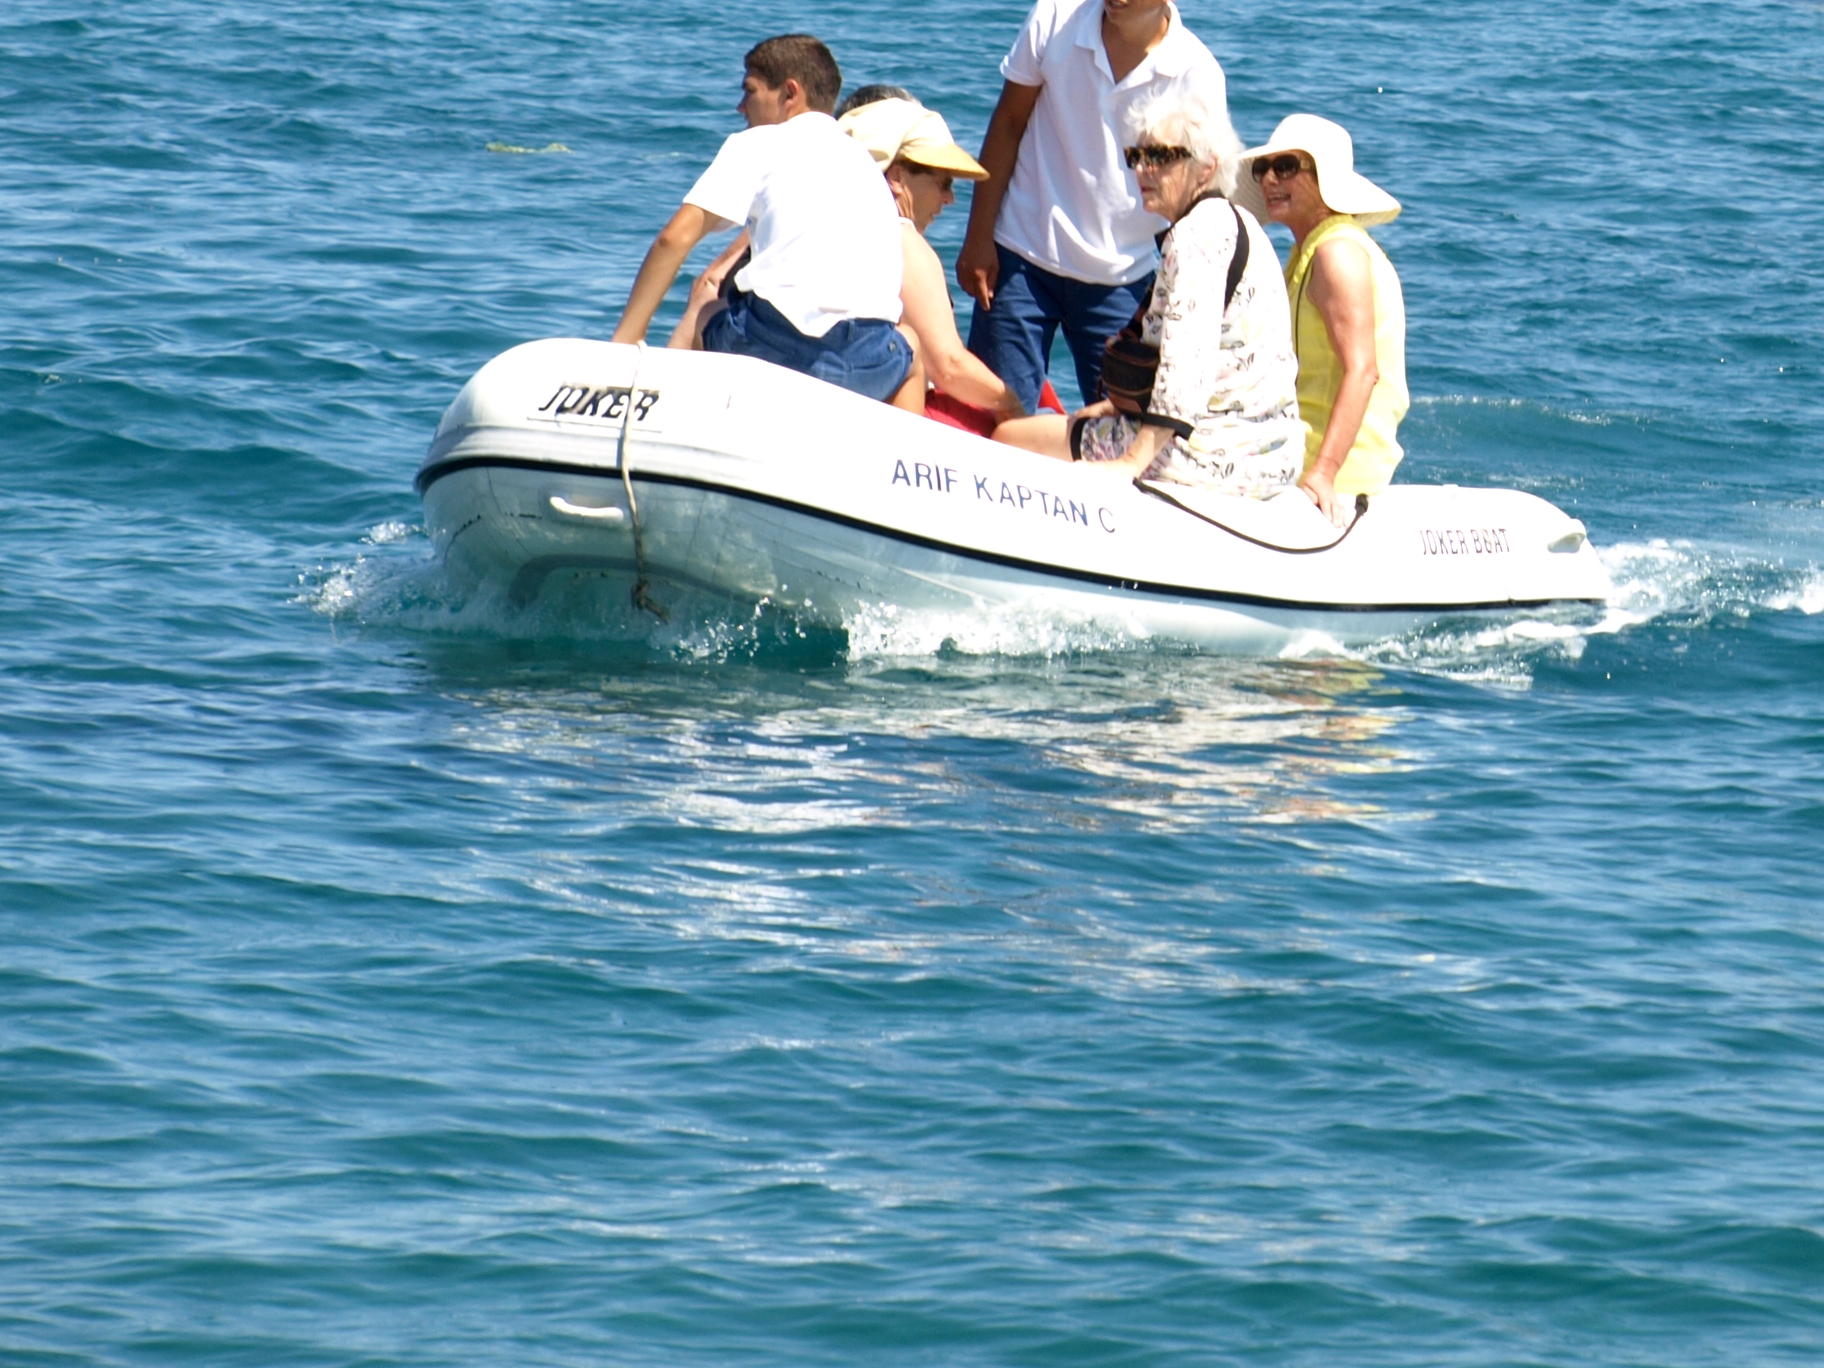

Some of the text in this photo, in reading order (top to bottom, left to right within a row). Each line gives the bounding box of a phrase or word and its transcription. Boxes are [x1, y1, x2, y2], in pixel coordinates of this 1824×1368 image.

[537, 384, 660, 422] JOKER
[891, 459, 1116, 533] ARIF KAPTAN C
[1420, 529, 1469, 555] JOKER
